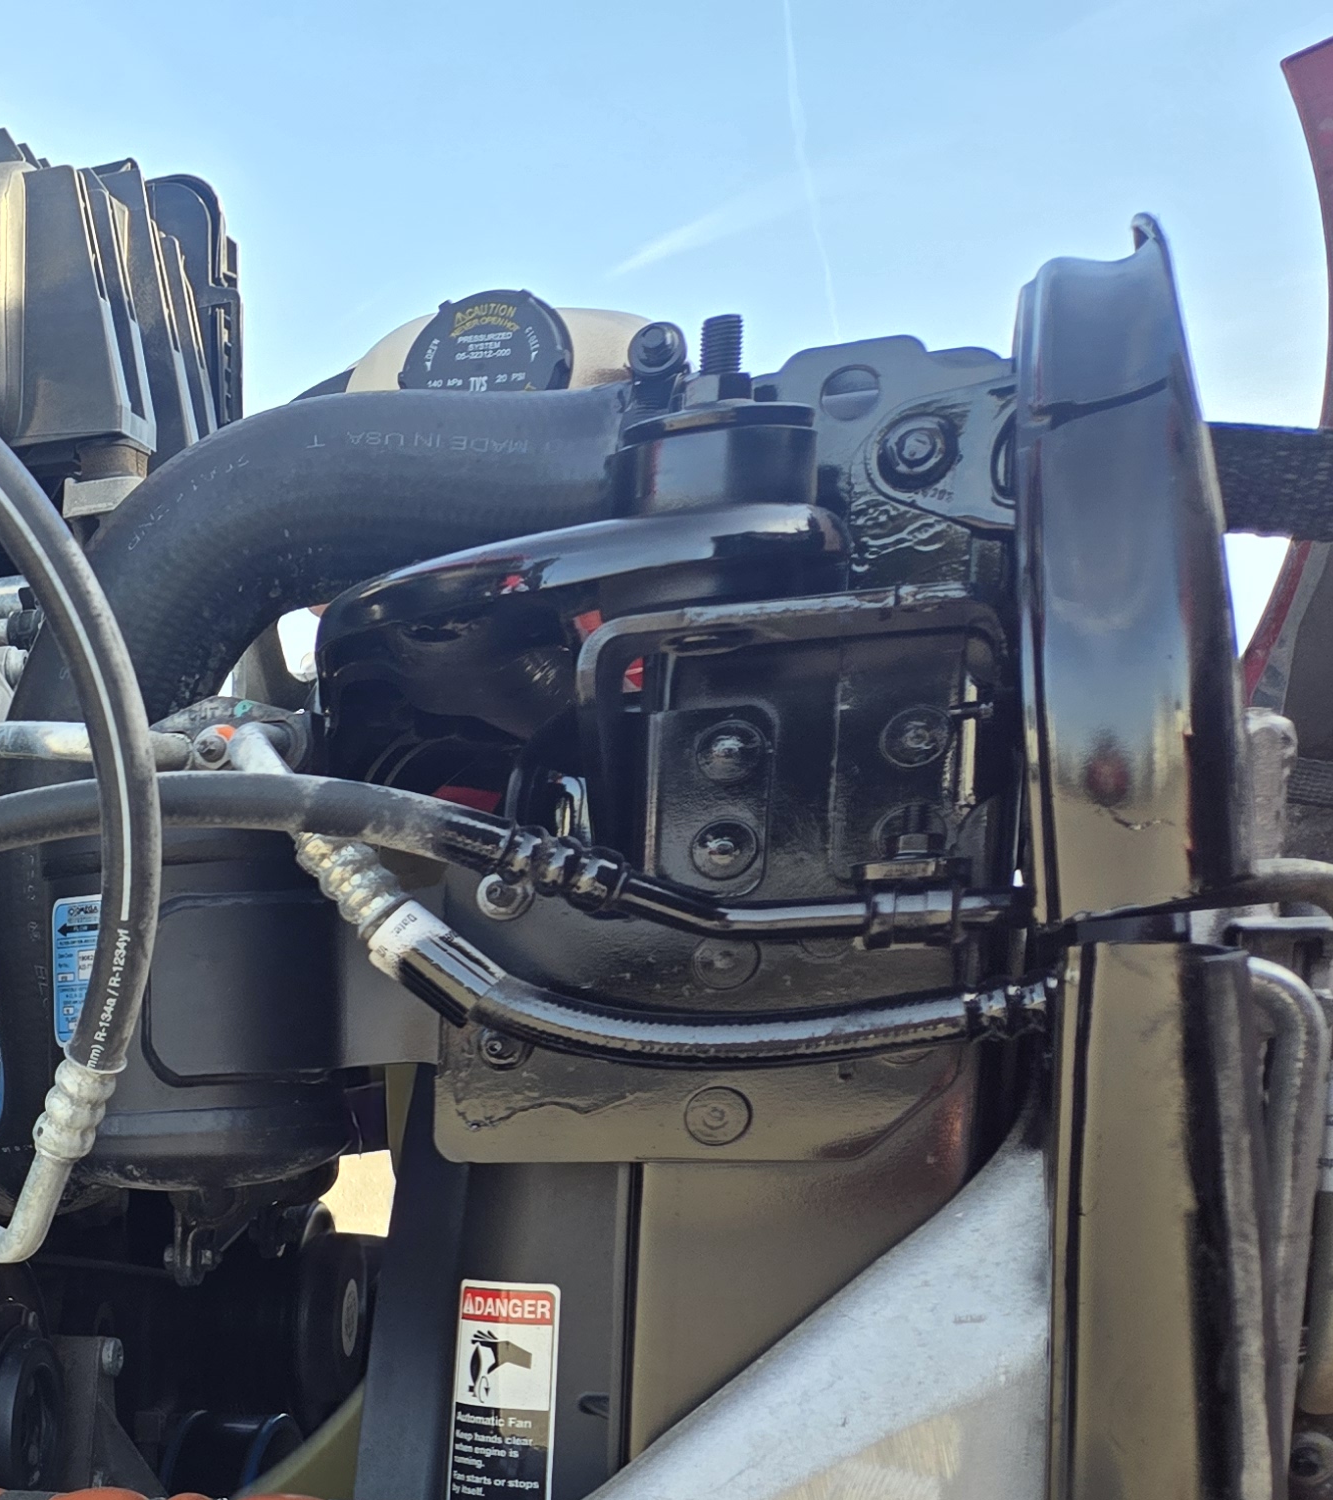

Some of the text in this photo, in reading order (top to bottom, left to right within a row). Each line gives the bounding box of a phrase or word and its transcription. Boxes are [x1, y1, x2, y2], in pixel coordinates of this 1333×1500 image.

[465, 303, 517, 319] CAUTION
[479, 316, 504, 329] OPEN
[502, 319, 521, 332] HOT
[456, 331, 513, 344] PRESSURIZED
[467, 341, 501, 352] SYSTEM
[468, 375, 489, 392] TVS
[495, 372, 526, 384] 20 PSI
[346, 430, 529, 454] MADE IN USA
[93, 997, 118, 1043] R-134a
[108, 928, 131, 988] R-1234yf
[474, 1295, 551, 1320] DANGER
[456, 1410, 532, 1429] Automatic Fan
[455, 1429, 533, 1447] Keep hands clear
[454, 1442, 520, 1458] when engine is
[453, 1455, 485, 1469] running.
[452, 1482, 461, 1494] by
[453, 1470, 540, 1490] Fan starts or stops
